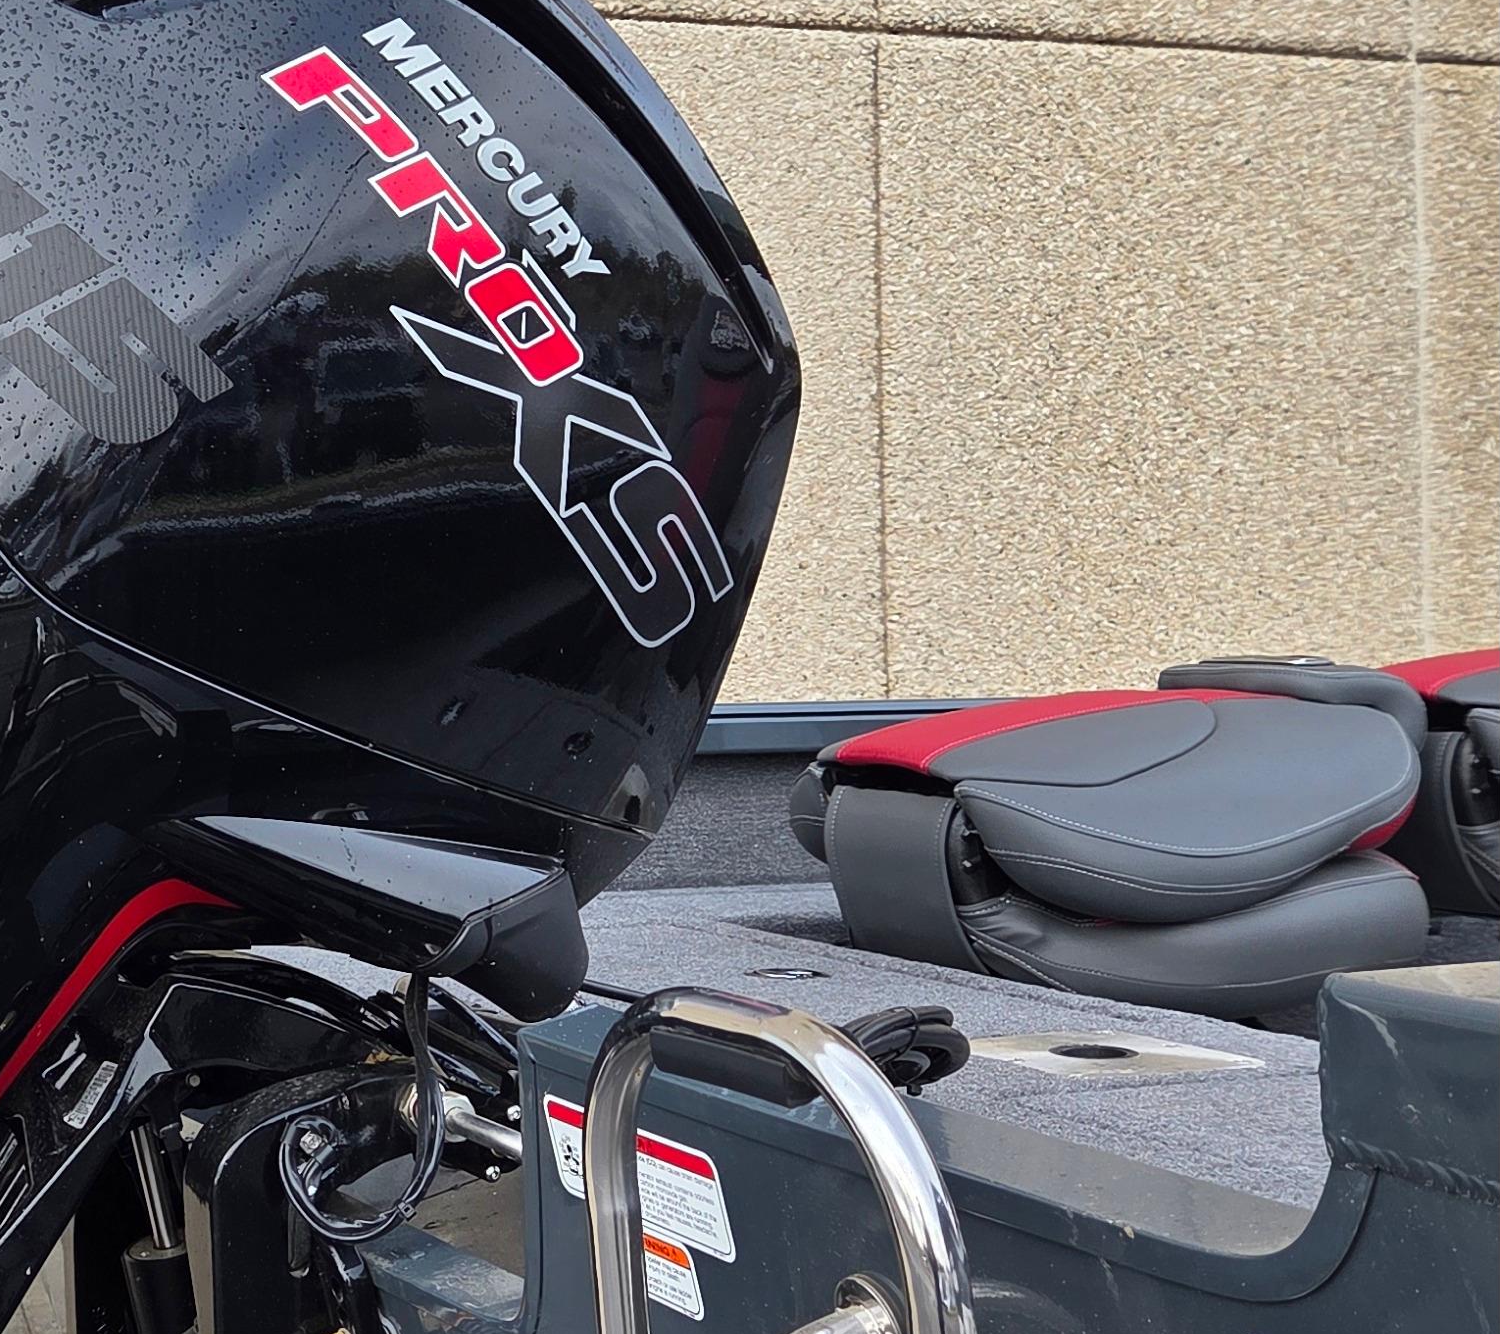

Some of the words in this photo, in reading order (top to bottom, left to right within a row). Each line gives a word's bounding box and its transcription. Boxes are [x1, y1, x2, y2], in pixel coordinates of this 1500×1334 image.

[261, 46, 584, 387] PRO
[362, 17, 611, 279] MERCURY
[389, 251, 734, 648] XS
